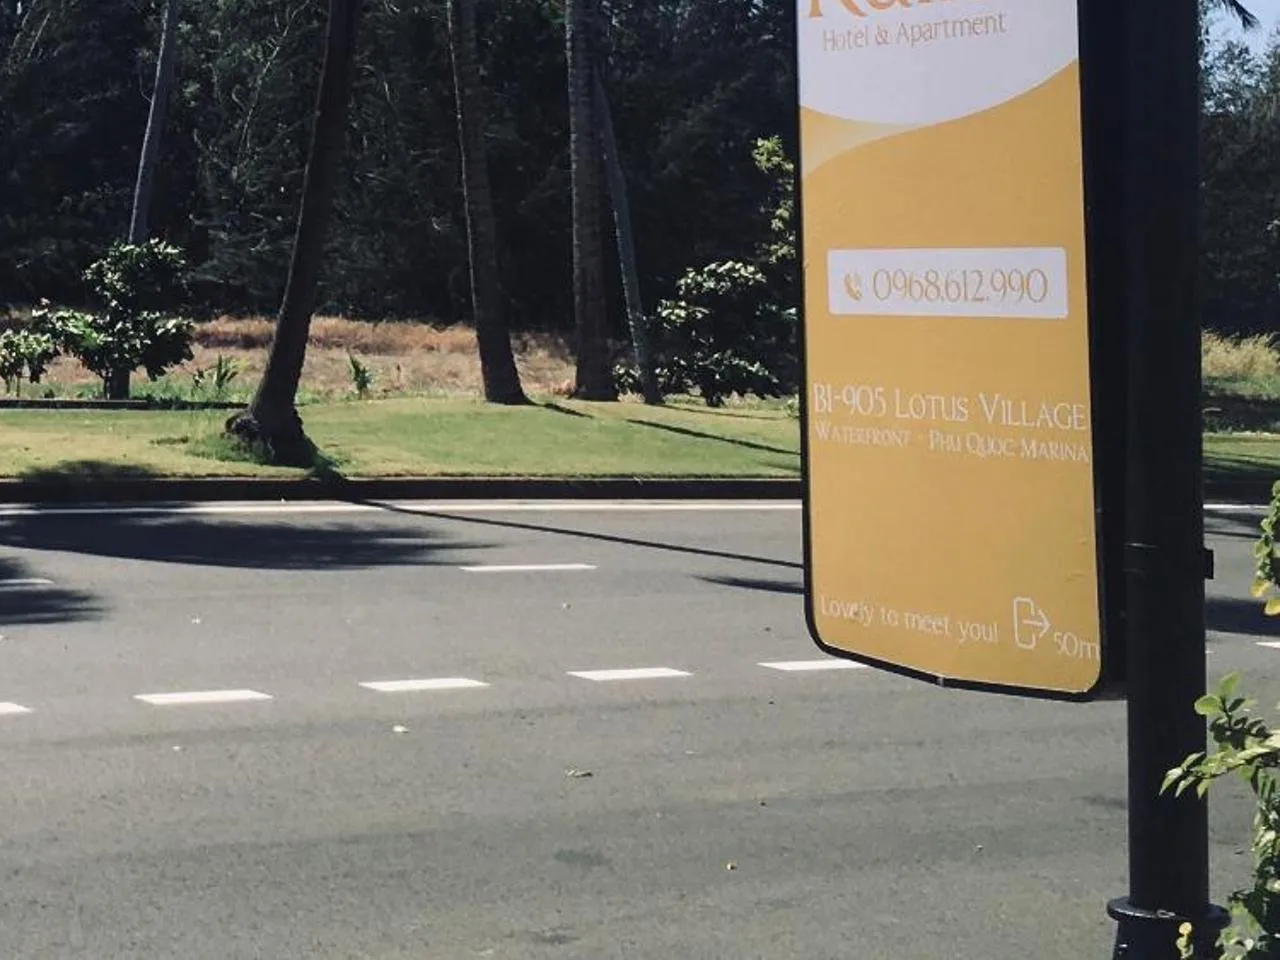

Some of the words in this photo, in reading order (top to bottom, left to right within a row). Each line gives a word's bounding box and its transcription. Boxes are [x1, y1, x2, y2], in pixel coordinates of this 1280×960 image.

[822, 25, 870, 52] Hotel
[875, 24, 890, 46] &
[896, 11, 1008, 48] Apartment
[894, 387, 969, 422] LOTUS
[978, 391, 1089, 430] VILLAGE
[1019, 437, 1090, 462] MARINA
[820, 595, 874, 626] Lovely
[881, 605, 899, 626] to
[904, 610, 952, 637] meet
